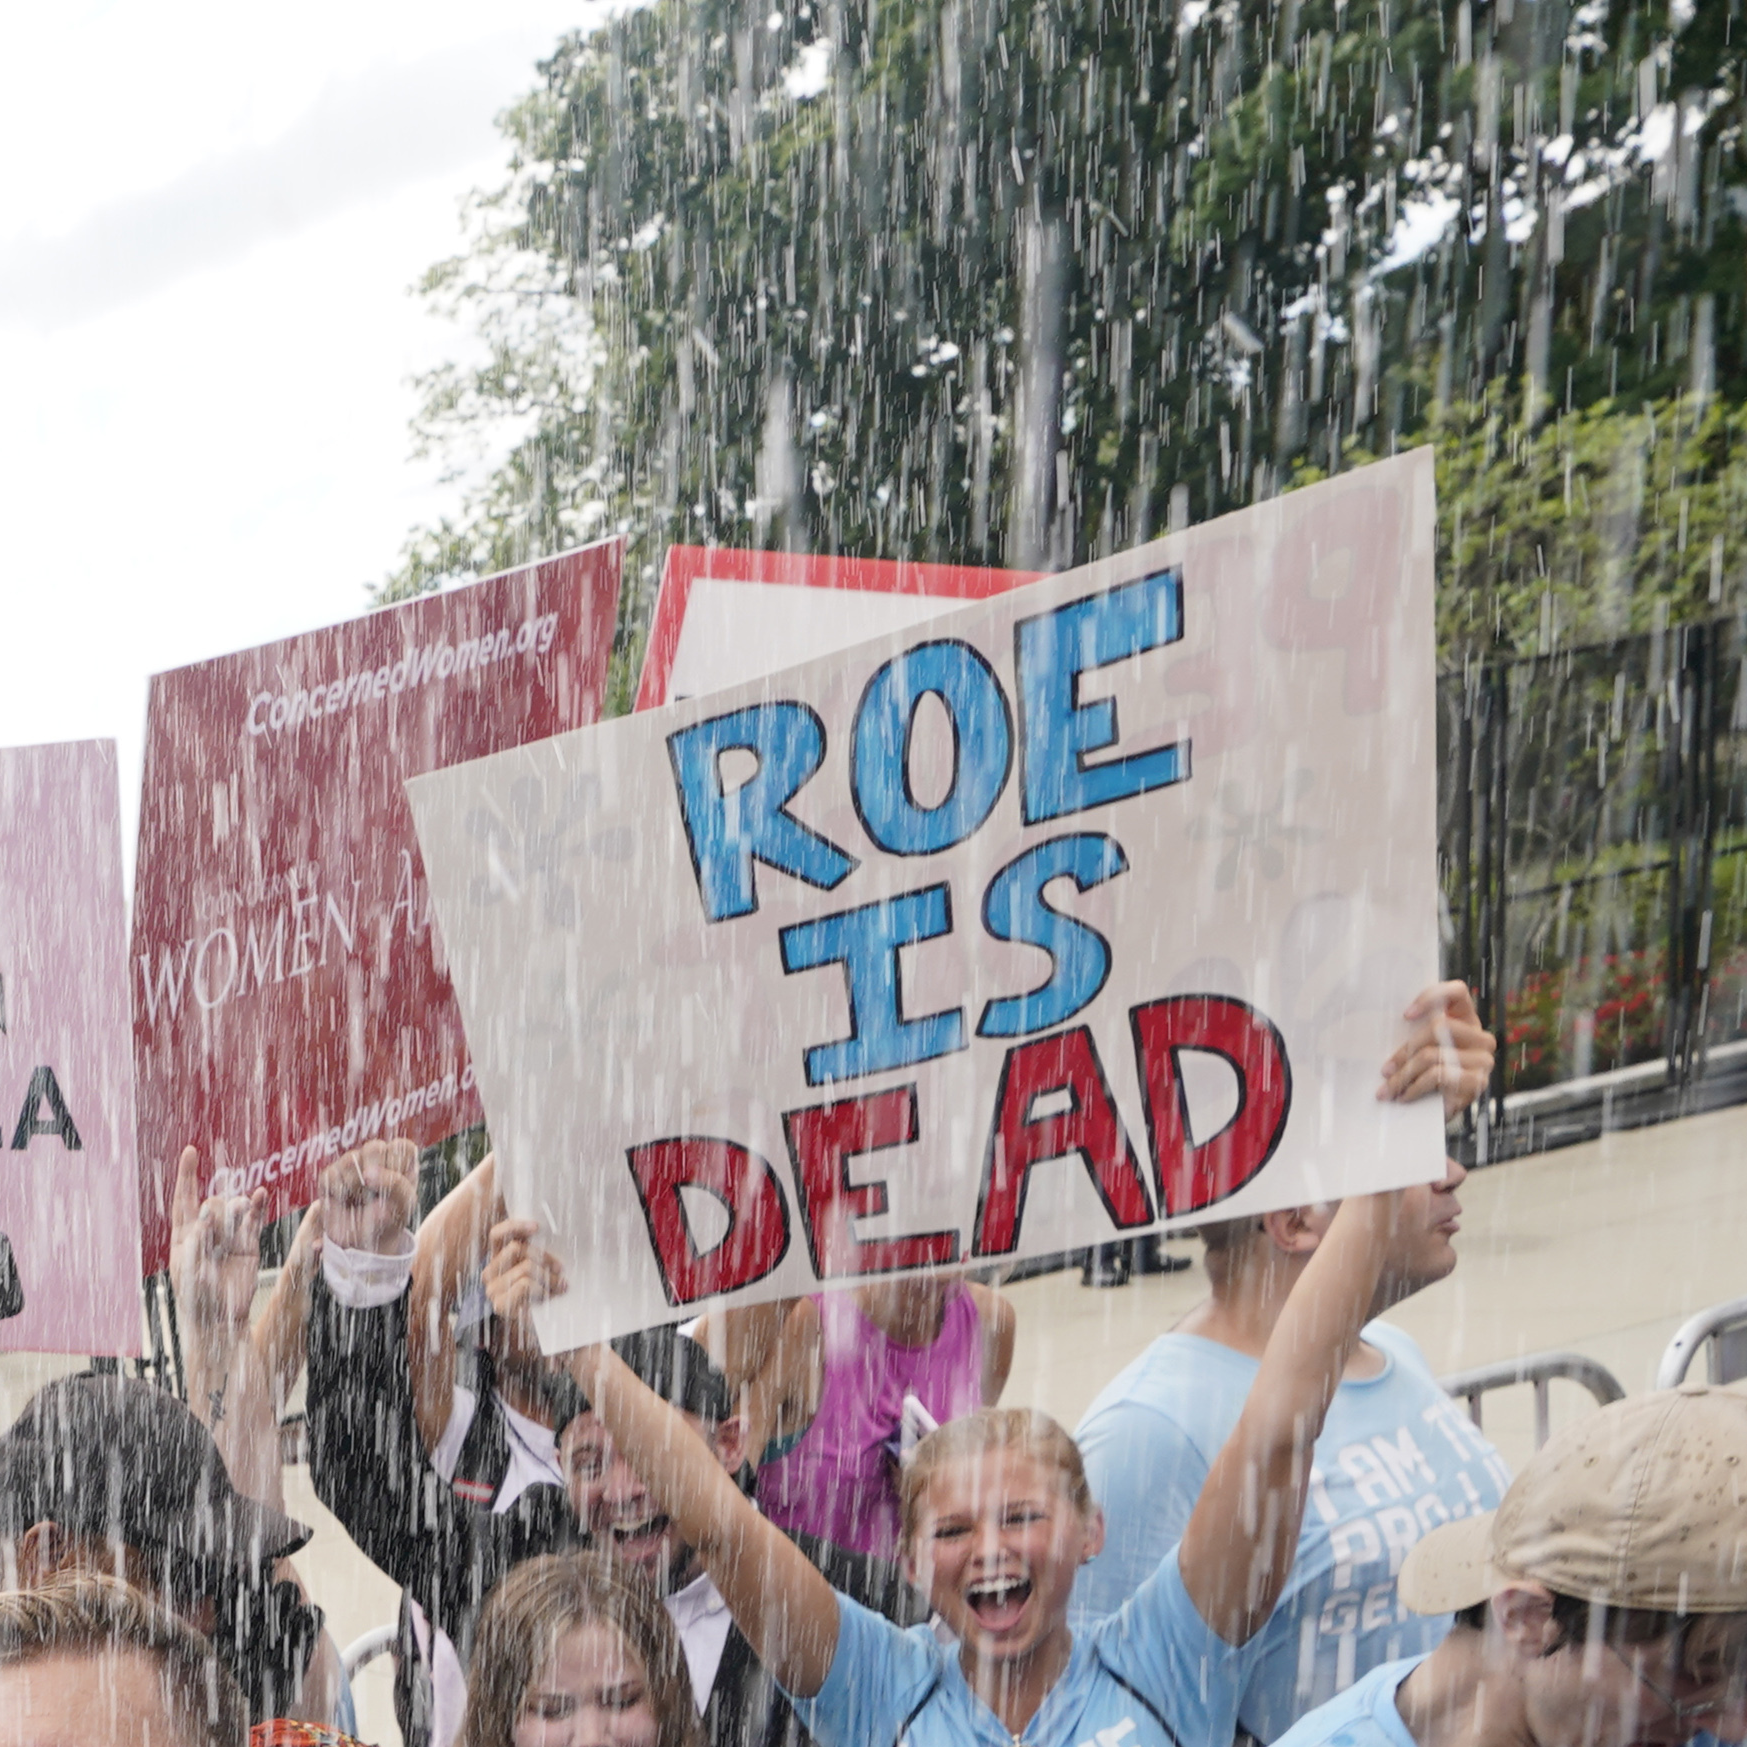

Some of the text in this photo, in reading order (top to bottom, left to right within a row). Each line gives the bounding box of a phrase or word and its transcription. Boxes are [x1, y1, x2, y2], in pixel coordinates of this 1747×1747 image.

[245, 611, 559, 736] ConcernedWomen.org
[667, 564, 1192, 922] ROE
[139, 880, 361, 1026] WOMEN
[778, 831, 1129, 1088] IS
[208, 1063, 479, 1197] ConcernedWomen.o
[626, 992, 1293, 1306] DEAD
[1338, 1425, 1437, 1505] AM
